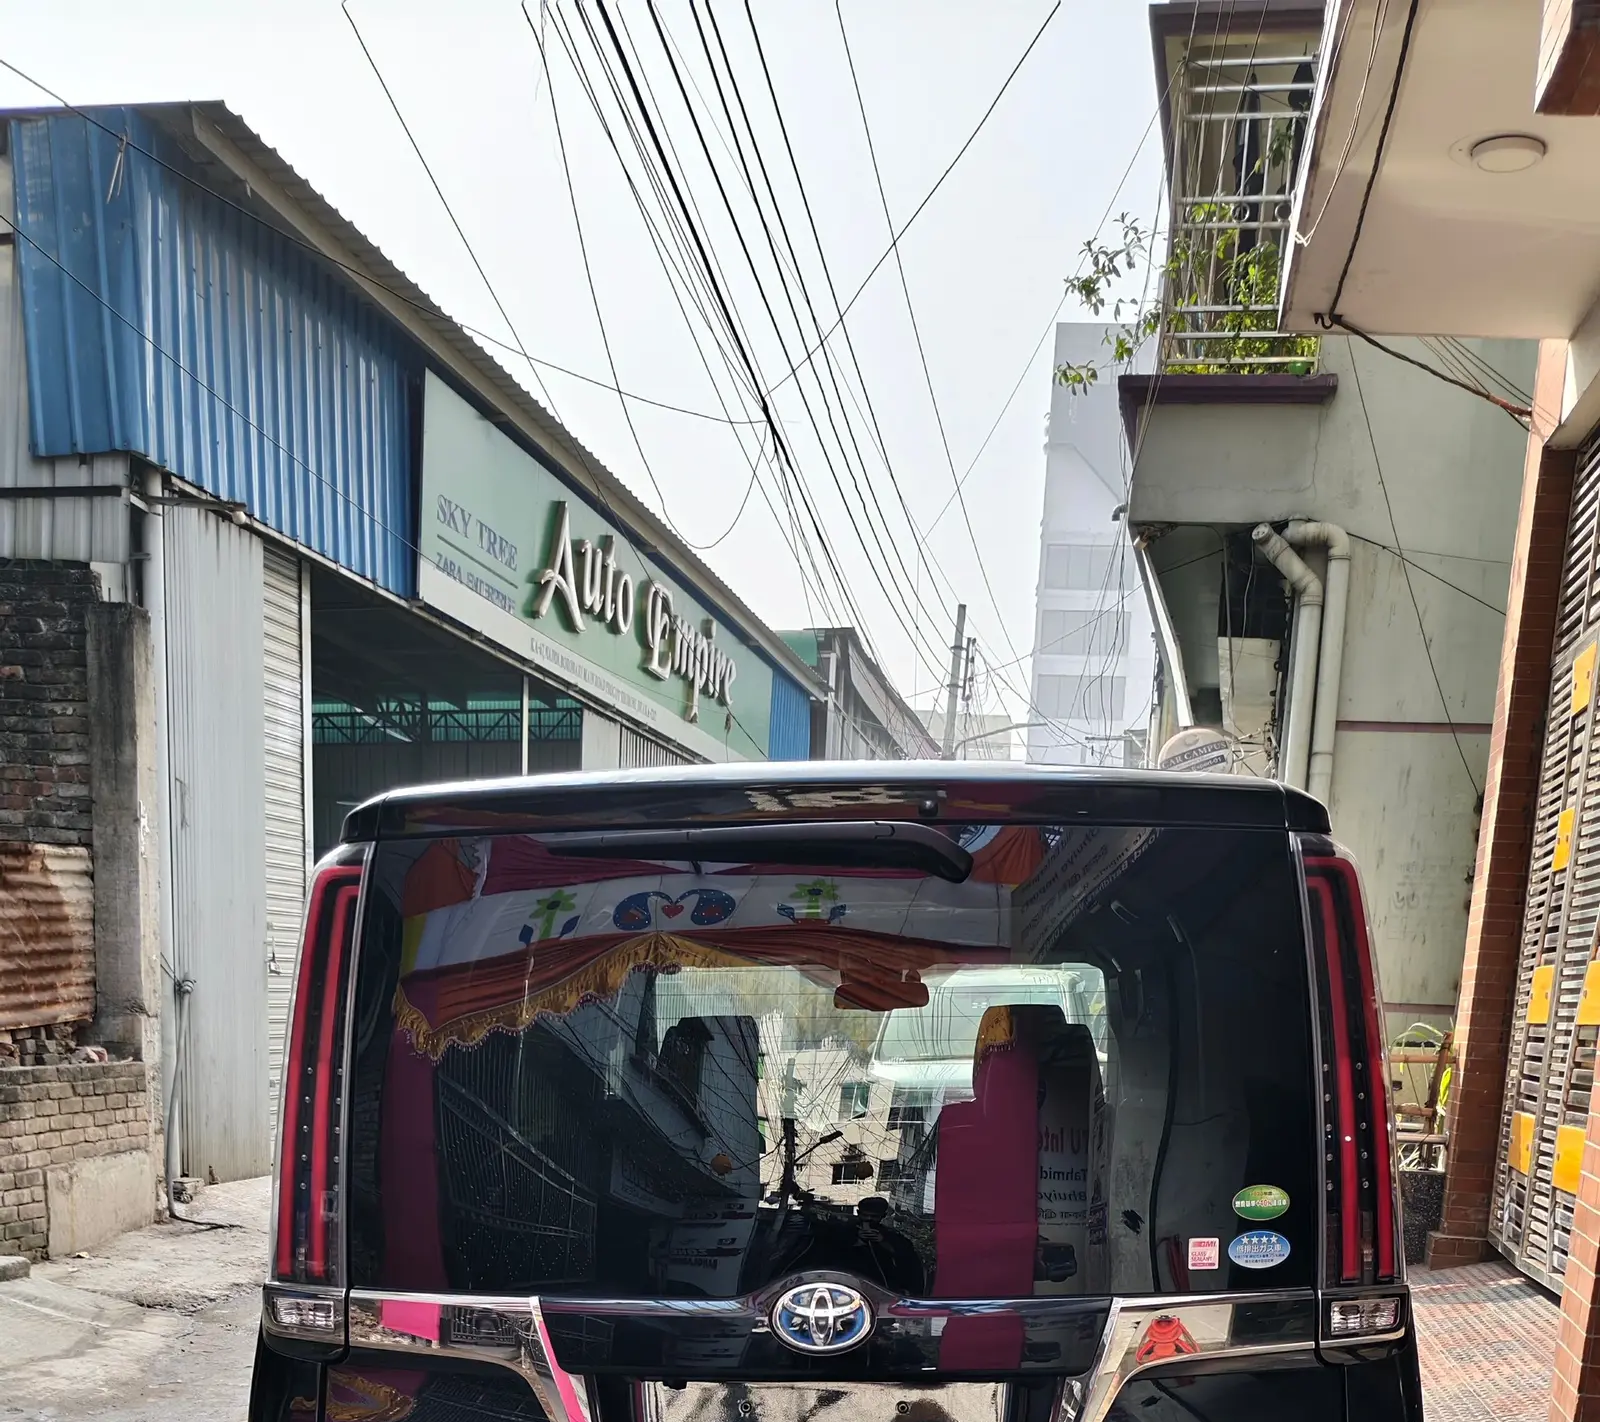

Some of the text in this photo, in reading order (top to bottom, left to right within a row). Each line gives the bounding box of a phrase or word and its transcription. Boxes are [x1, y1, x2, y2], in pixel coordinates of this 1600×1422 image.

[437, 494, 518, 572] SKY TREE
[434, 552, 464, 585] ZARA
[535, 500, 634, 636] Auto
[645, 579, 737, 724] Empire
[1161, 740, 1227, 769] CAR CAMPUS
